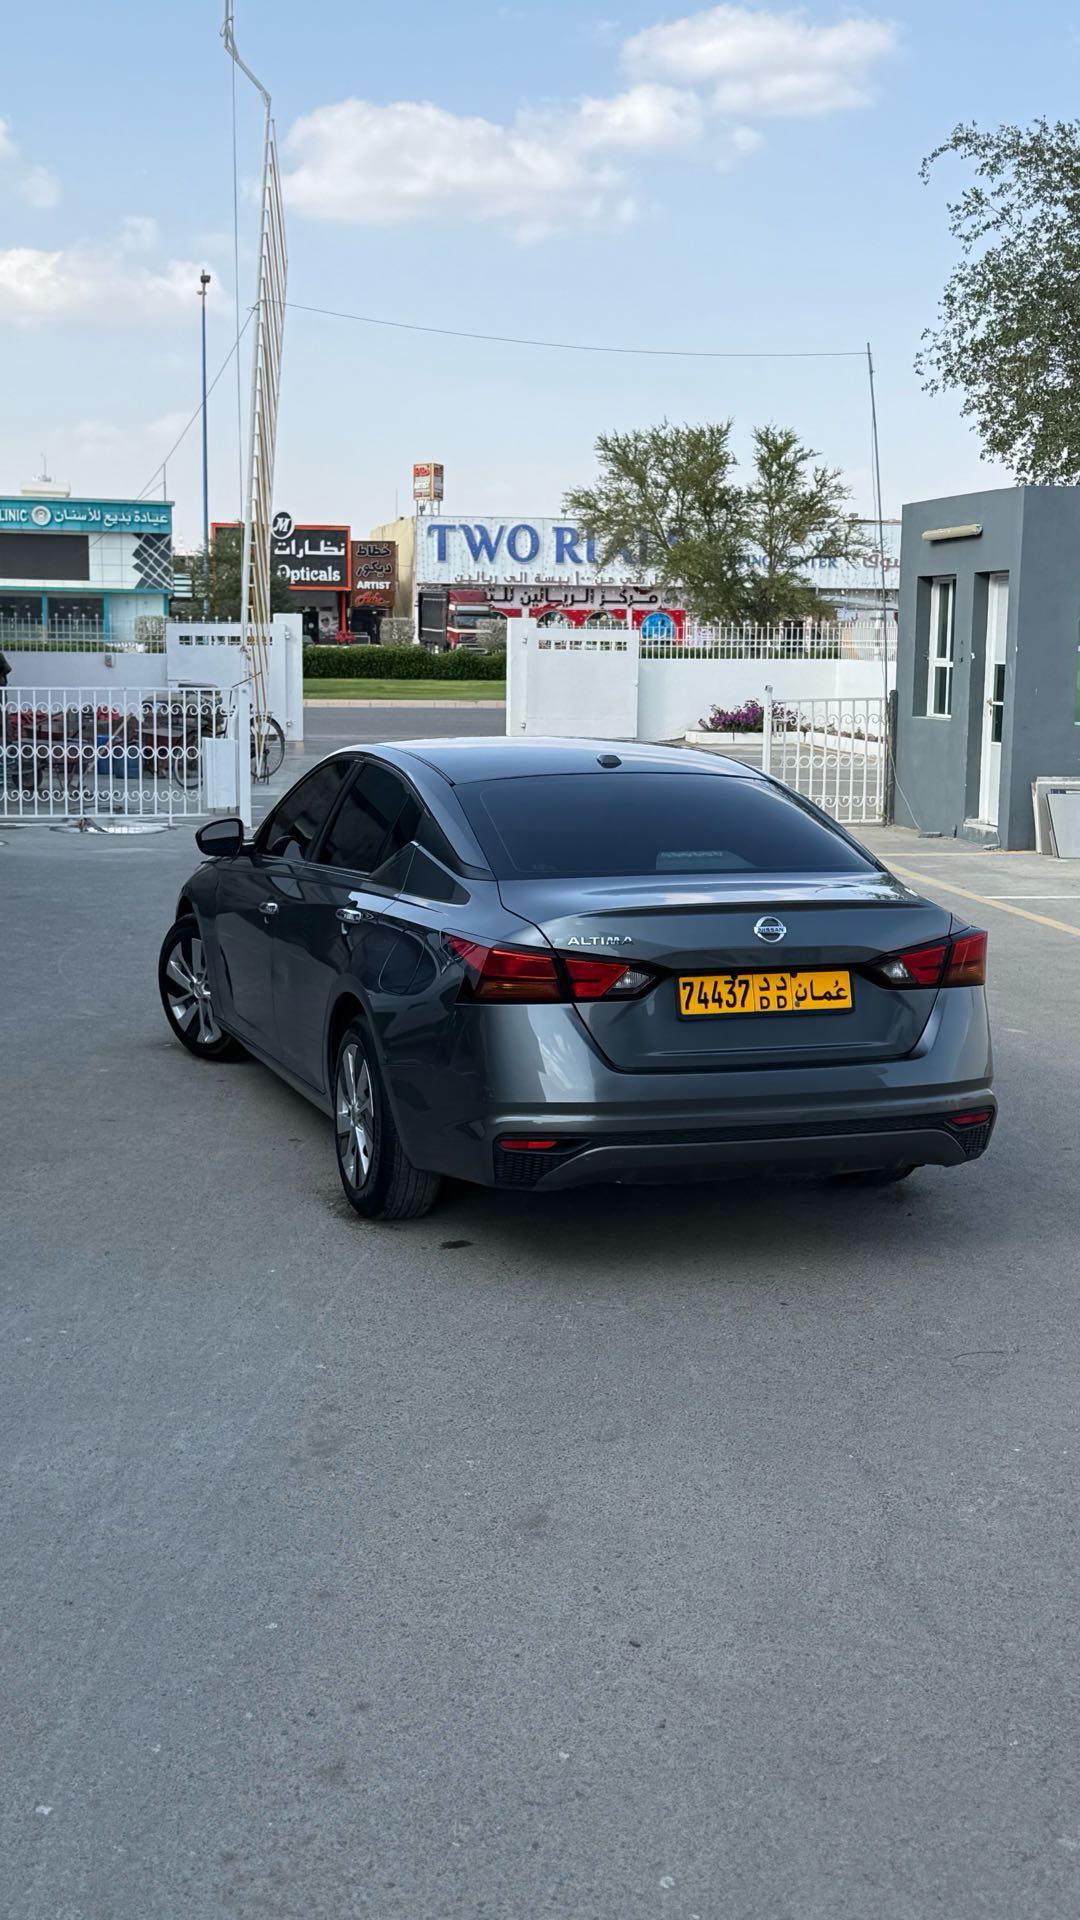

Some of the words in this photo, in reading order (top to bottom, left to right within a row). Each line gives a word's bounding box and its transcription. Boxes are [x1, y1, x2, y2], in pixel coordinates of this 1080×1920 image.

[54, 507, 101, 523] للأسنان
[103, 511, 132, 527] بديع
[133, 510, 168, 526] عيادة
[273, 517, 292, 532] M
[274, 539, 346, 558] نظارات
[356, 544, 391, 557] خطاط
[427, 524, 540, 564] TWO
[277, 565, 341, 584] Opticals
[356, 560, 392, 577] ديكور
[357, 581, 392, 590] ARTIST
[454, 571, 498, 585] ريالين
[599, 587, 659, 609] مركز
[756, 926, 785, 934] NISSAN
[567, 936, 635, 946] ALTIMA
[682, 979, 751, 1010] 74437
